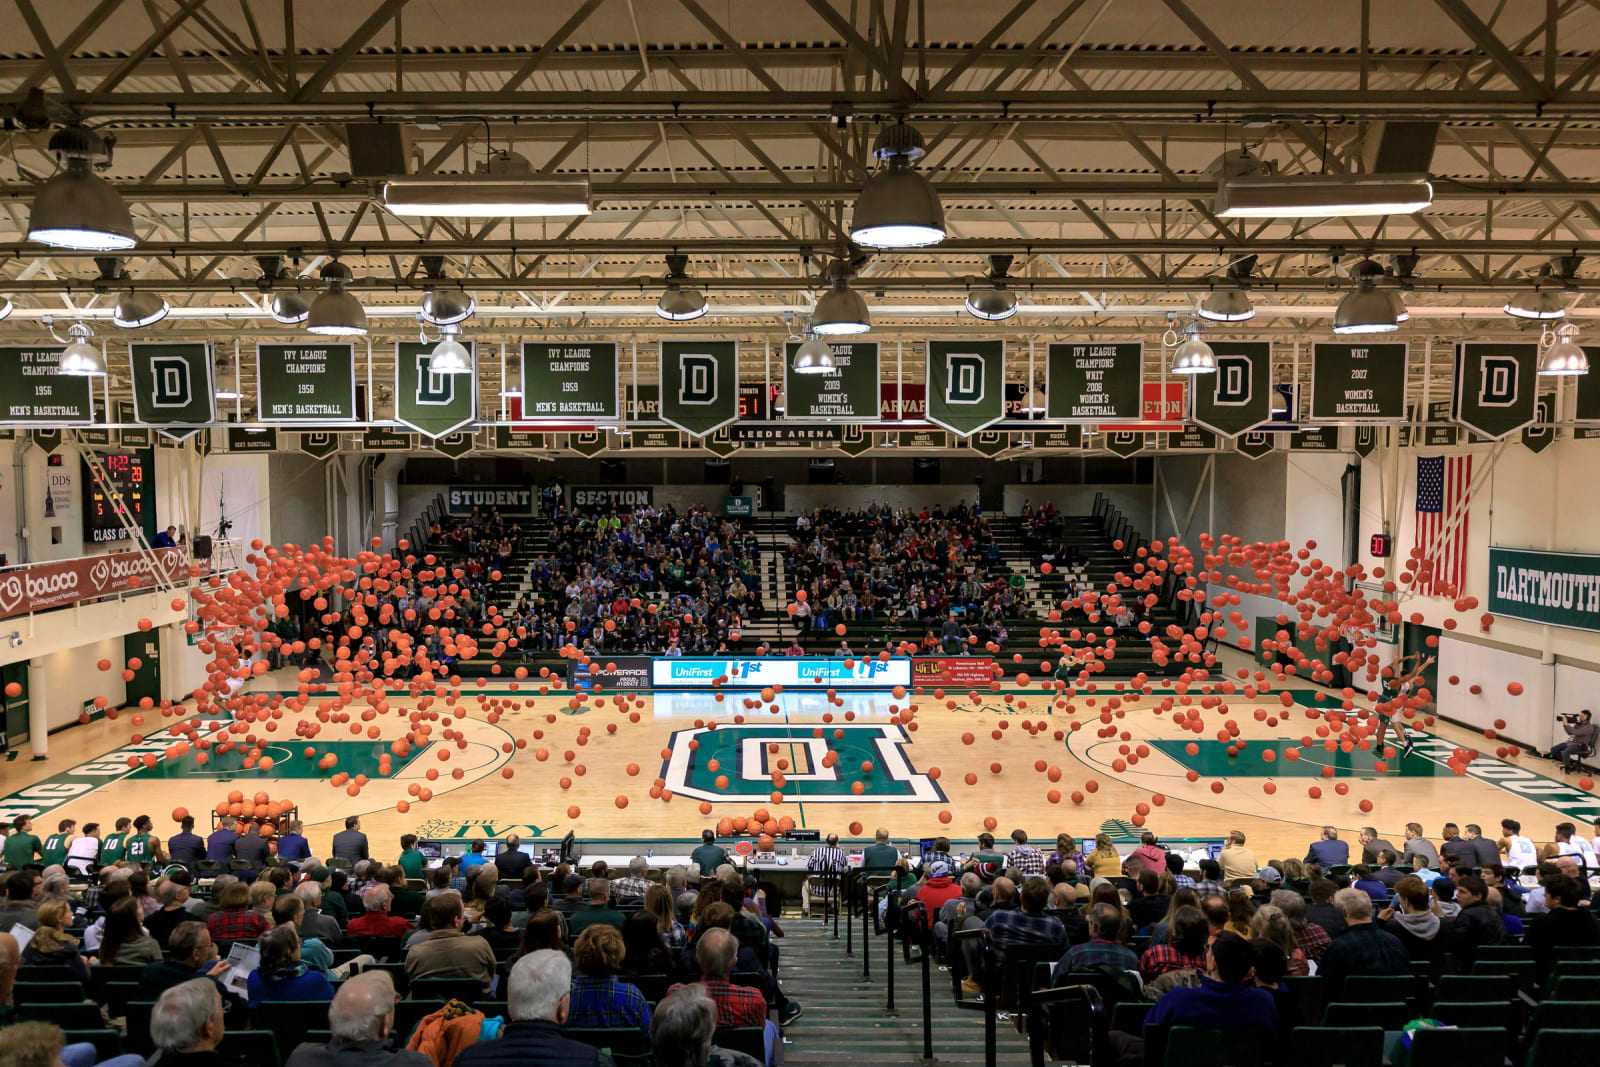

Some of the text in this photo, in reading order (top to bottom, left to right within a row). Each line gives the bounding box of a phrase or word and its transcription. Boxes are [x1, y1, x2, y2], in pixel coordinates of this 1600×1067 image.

[284, 351, 327, 360] IVY LEAGUE
[548, 349, 590, 358] IVY LEAGUE
[1073, 347, 1116, 356] IVY LEAGUE
[1351, 349, 1369, 358] WNIT
[21, 353, 33, 362] IVY
[286, 364, 326, 373] CHAMPIONS
[550, 362, 589, 371] CHAMPIONS
[1076, 359, 1114, 368] CHAMPIONS
[22, 366, 60, 375] CHAMPION
[1085, 371, 1104, 380] WNIT
[1351, 369, 1367, 379] 2007
[150, 356, 192, 408] D
[679, 354, 718, 405] D
[946, 353, 985, 404] D
[1214, 355, 1252, 406] D
[1478, 356, 1519, 407] D
[35, 386, 52, 396] 1956
[298, 384, 314, 394] 1958
[562, 382, 579, 392] 1959
[818, 392, 848, 403] WOMEN'S
[1079, 393, 1109, 403] WOMEN'S
[1344, 389, 1374, 400] WOMEN'S
[10, 406, 80, 416] MEN'S BASKETBALL
[272, 405, 341, 414] MEN'S BASKETBALL
[536, 402, 604, 412] MEN'S BASKETBALL
[810, 405, 854, 415] BASKETBALL
[1072, 406, 1116, 416] BASKETBALL
[1336, 404, 1380, 413] BASKETBALL
[739, 430, 833, 438] LEEDE ARENA
[52, 476, 71, 486] DDS
[451, 490, 649, 505] STUDENT SECTION
[94, 529, 116, 541] CLASS
[118, 528, 127, 539] OF
[1372, 536, 1384, 554] 30
[25, 571, 78, 598] boloco
[1497, 565, 1600, 612] DARTMOUTH
[675, 667, 840, 677] UniFirst UniFirst
[659, 722, 950, 804] D
[449, 825, 559, 838] IVY
[46, 839, 59, 850] 11
[104, 839, 118, 850] 10
[131, 842, 143, 854] 23
